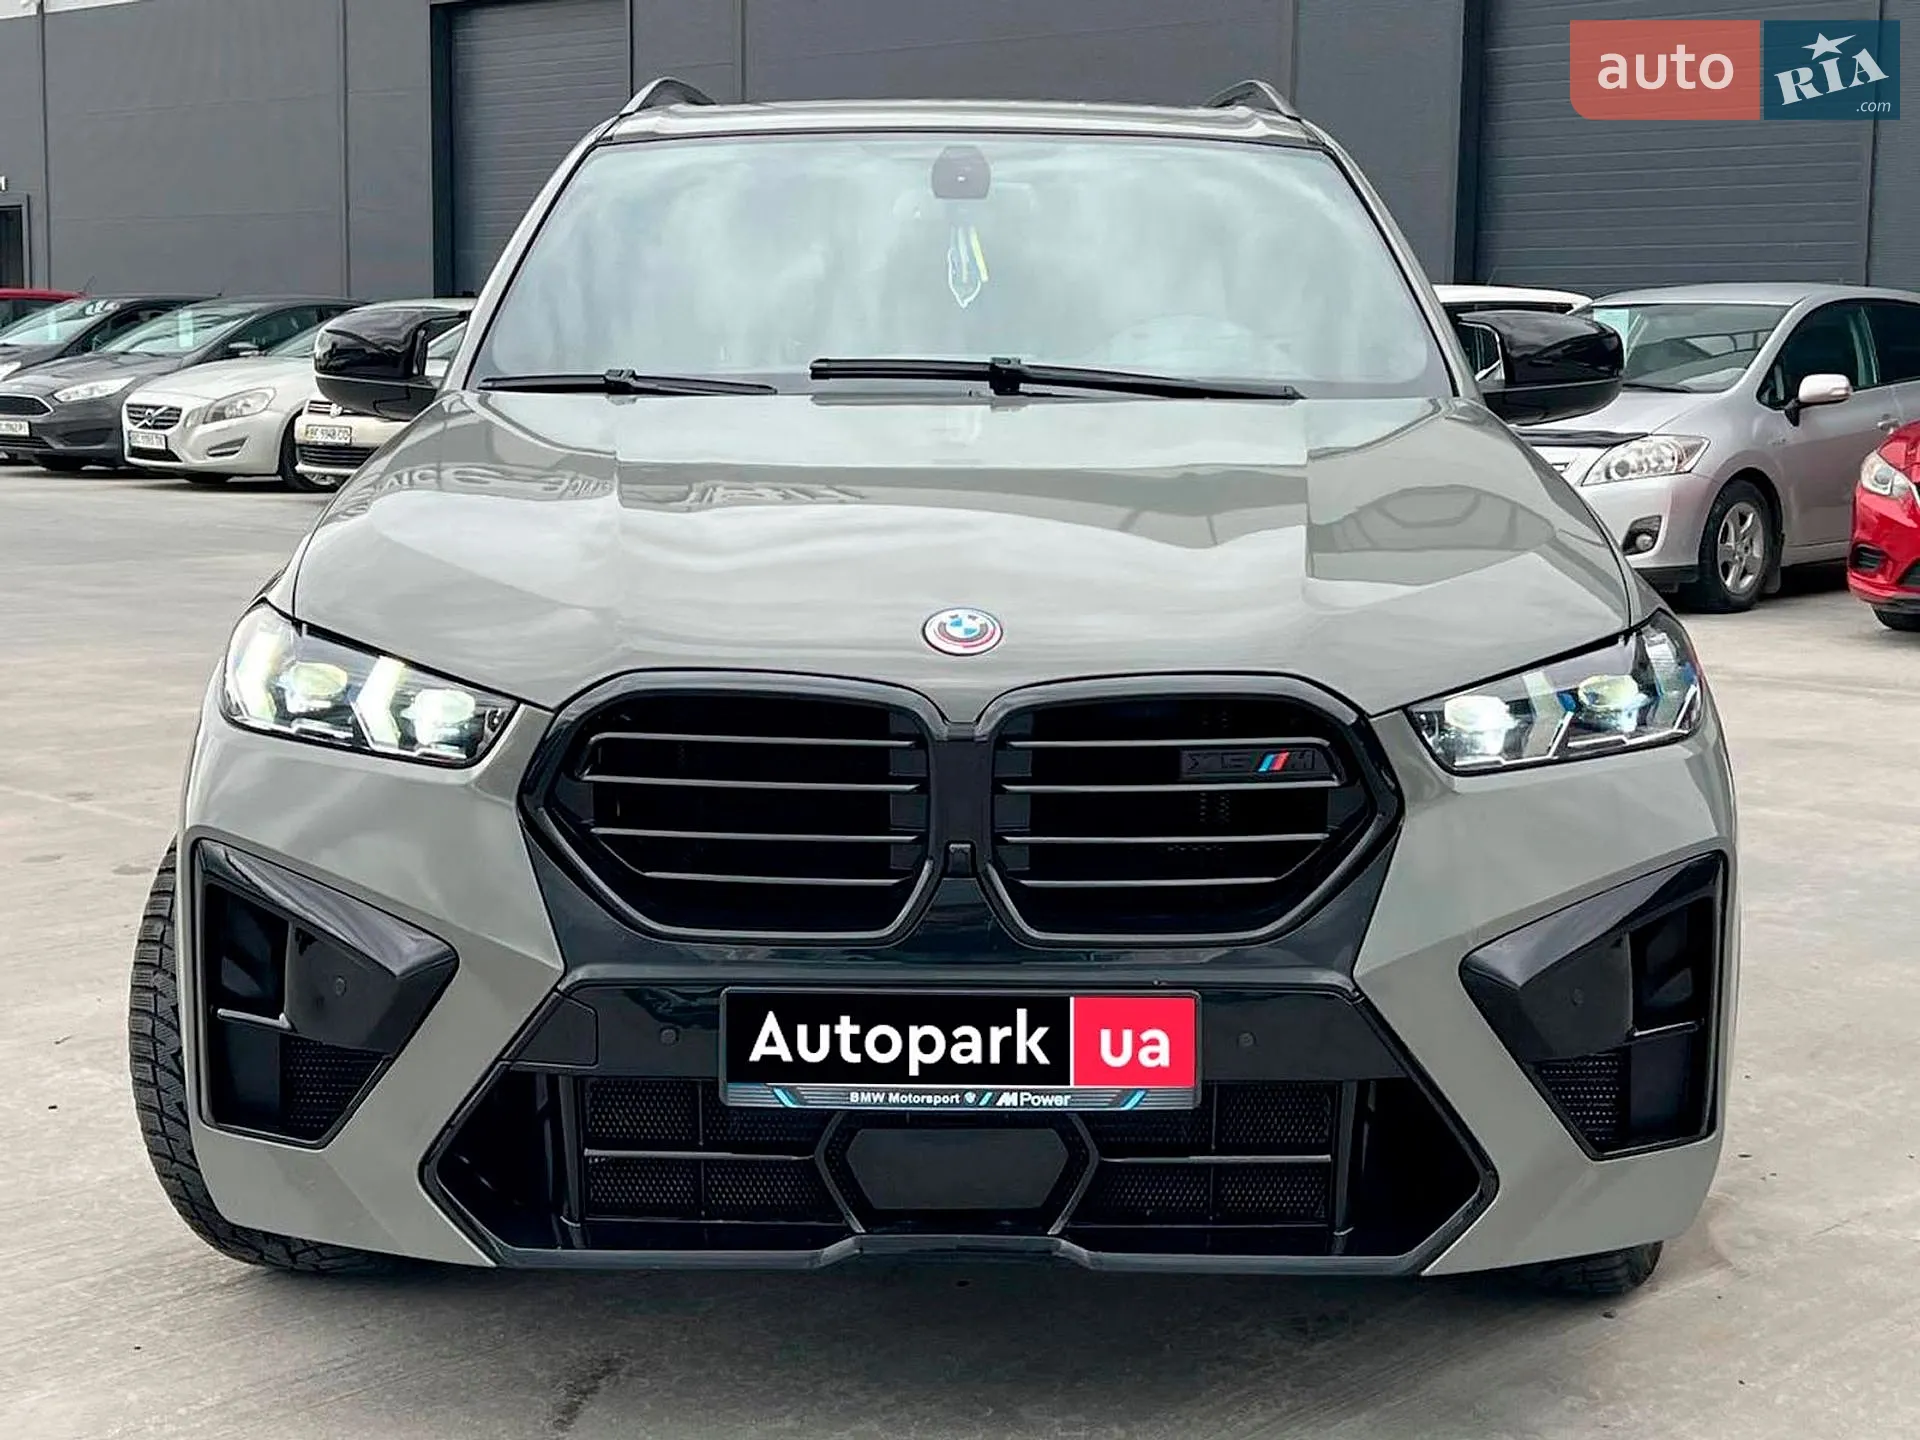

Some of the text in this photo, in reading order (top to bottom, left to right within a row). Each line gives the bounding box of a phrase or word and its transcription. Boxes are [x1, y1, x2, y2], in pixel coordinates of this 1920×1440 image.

[749, 1008, 1170, 1077] Autopark ua
[850, 1092, 884, 1103] BMW
[888, 1092, 960, 1106] Motorsport
